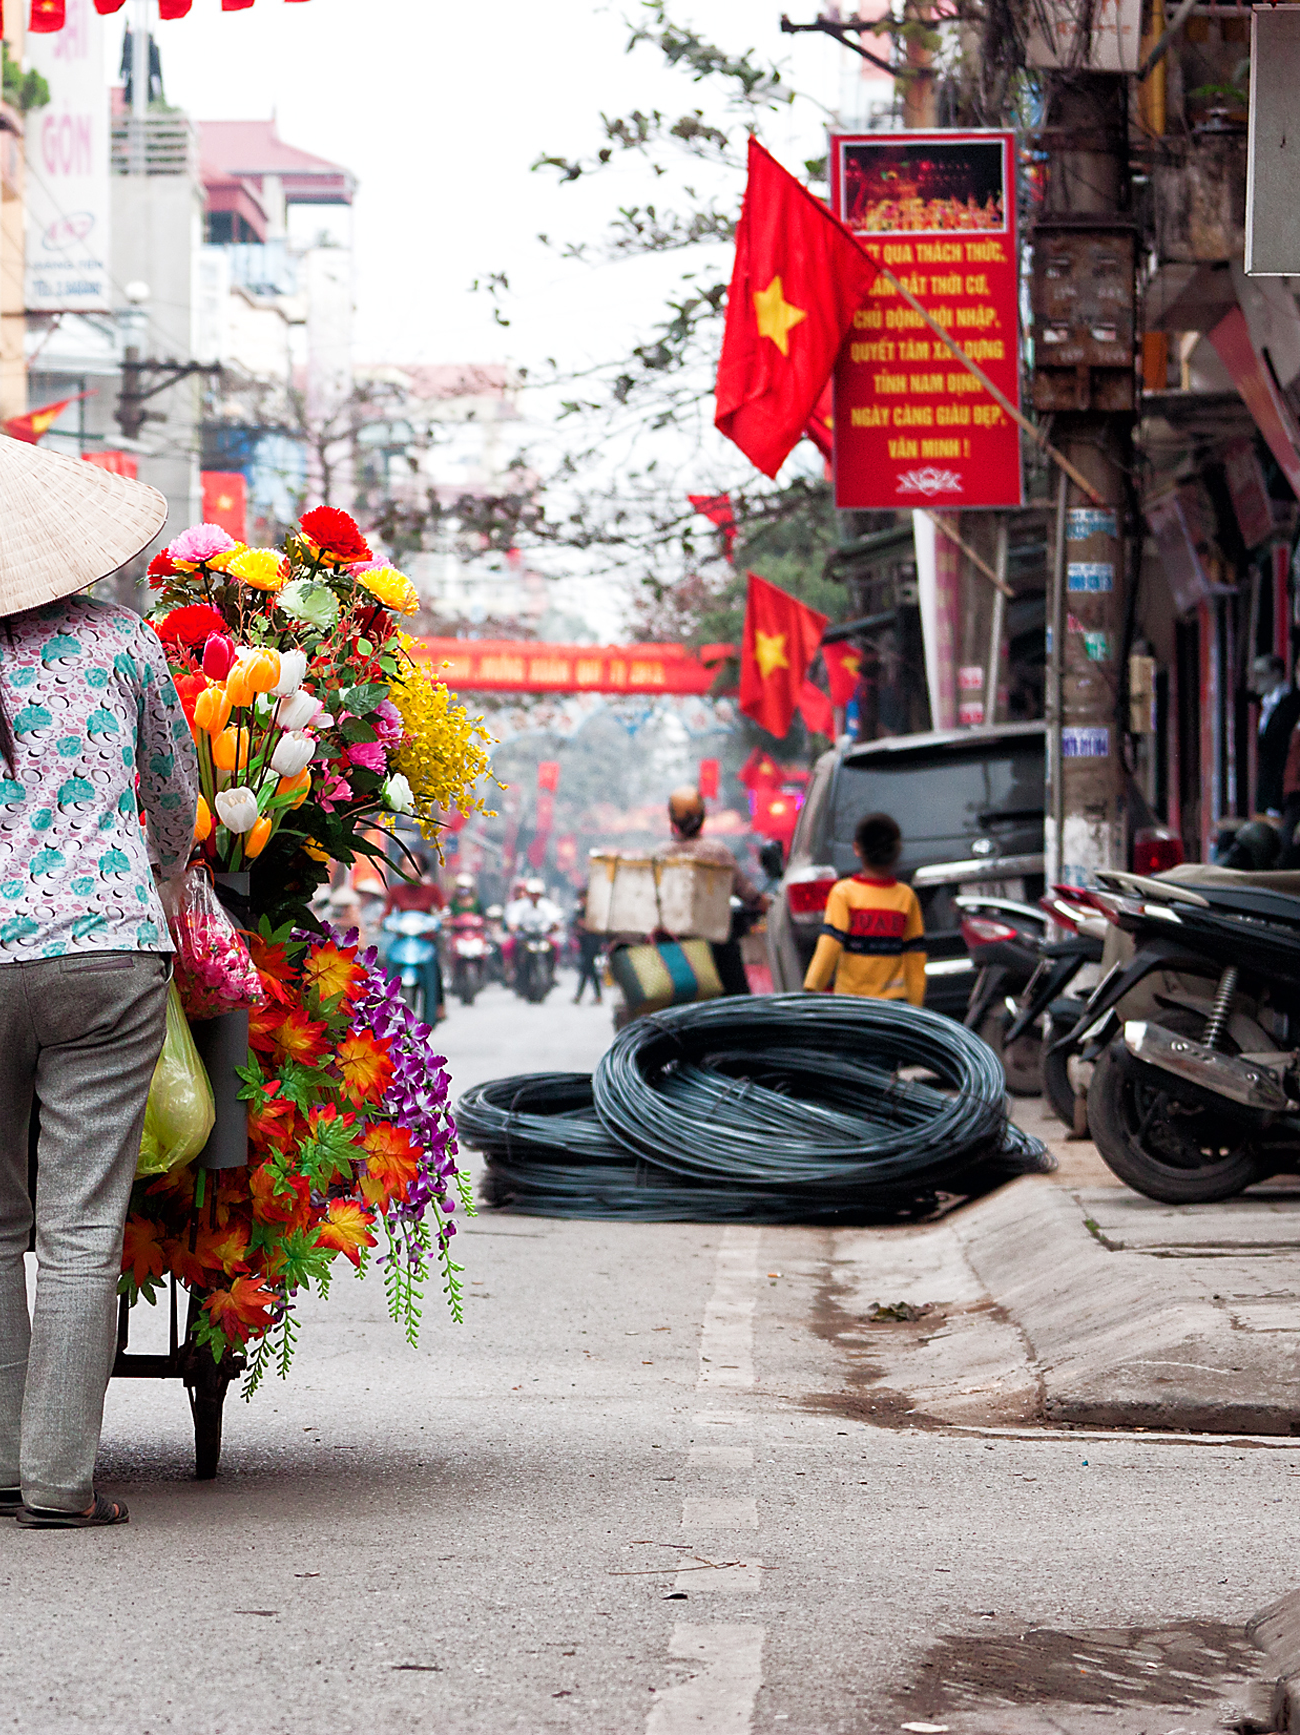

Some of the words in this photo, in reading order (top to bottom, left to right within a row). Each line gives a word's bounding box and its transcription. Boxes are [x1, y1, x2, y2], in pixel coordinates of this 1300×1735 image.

[883, 243, 914, 265] QUA
[915, 240, 963, 263] THÁCH
[930, 270, 963, 296] THỜI
[853, 302, 882, 329] CHỦ
[851, 336, 895, 364] QUYẾT
[898, 337, 930, 361] TÂM
[874, 368, 907, 394] TỈNH
[910, 374, 944, 393] NAM
[851, 403, 889, 427] NGÀY
[893, 403, 933, 427] CÀNG
[936, 402, 970, 425] GIÀU
[888, 435, 918, 459] VĂN
[921, 438, 961, 459] MINH
